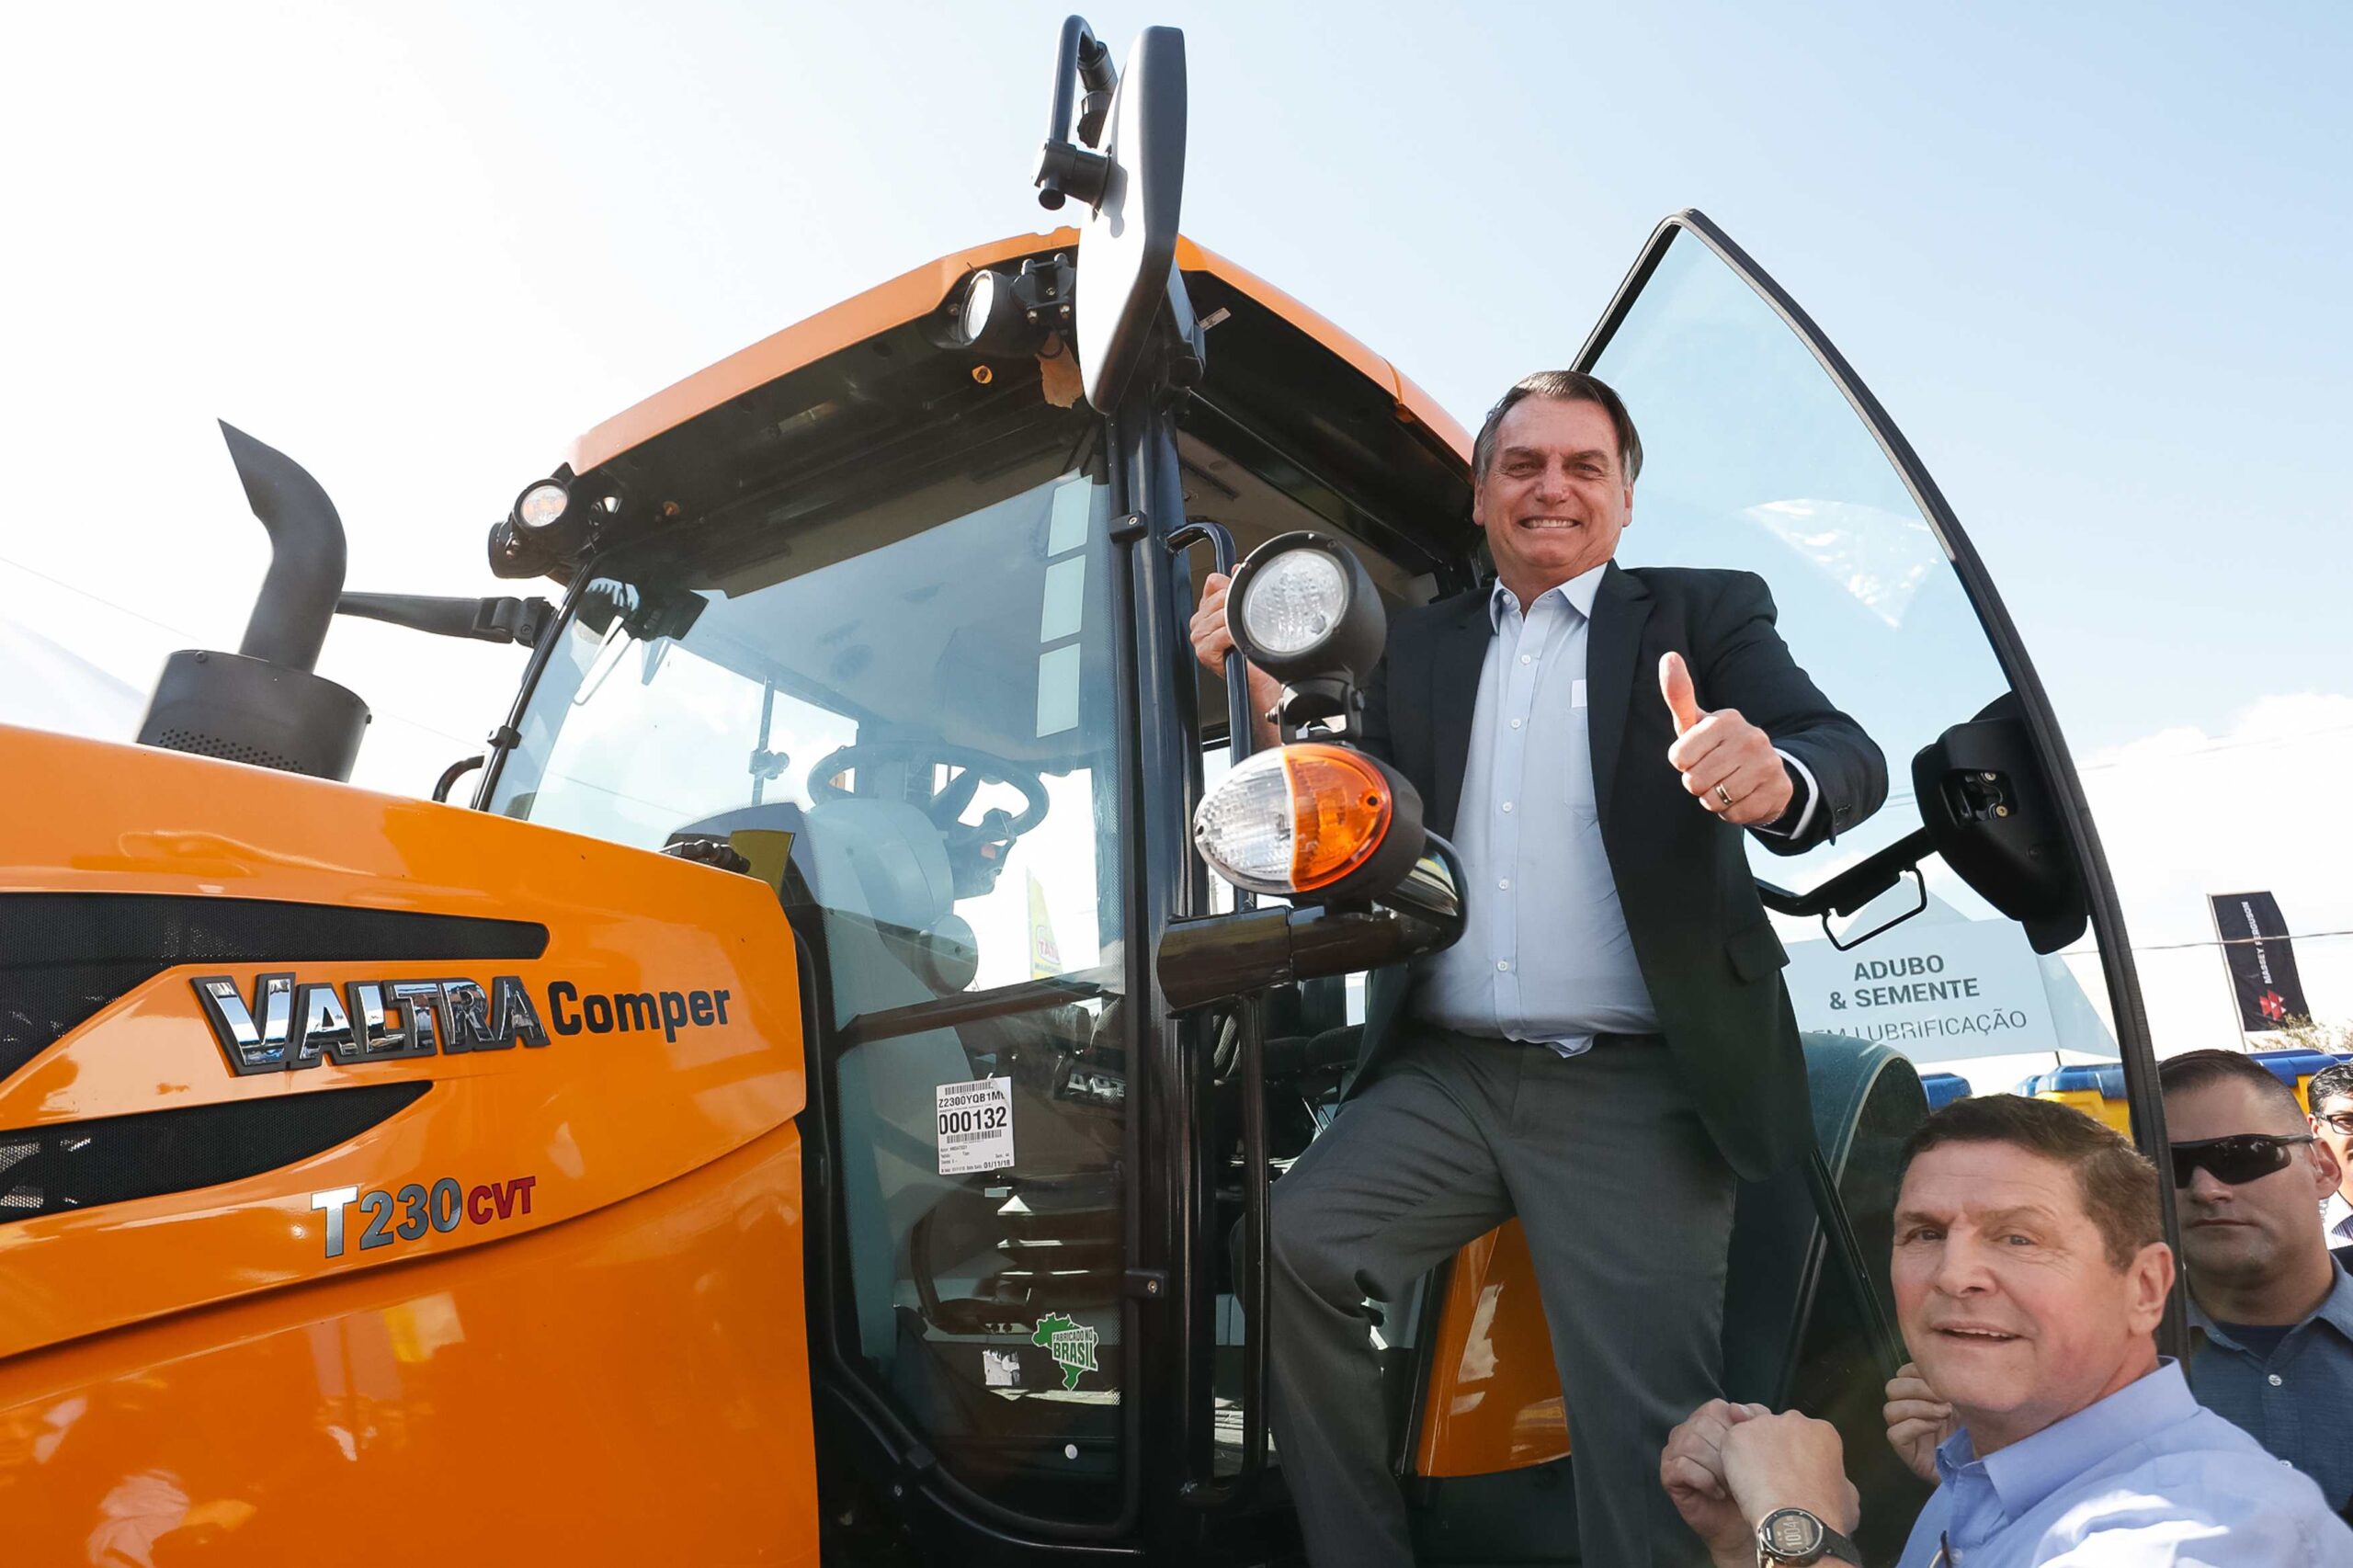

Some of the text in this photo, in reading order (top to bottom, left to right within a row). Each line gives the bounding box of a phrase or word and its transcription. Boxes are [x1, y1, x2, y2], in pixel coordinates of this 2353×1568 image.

[2241, 901, 2272, 984] MASSEY FERGUSON
[1854, 954, 1945, 982] ADUBO
[1829, 978, 1980, 1010] & SEMENTE
[189, 971, 731, 1076] VALTRA Comper
[938, 1106, 1007, 1135] 000132
[311, 1176, 537, 1258] T230 CVT
[1052, 1328, 1094, 1342] FABRICADO NO
[1053, 1341, 1097, 1369] BRASIL
